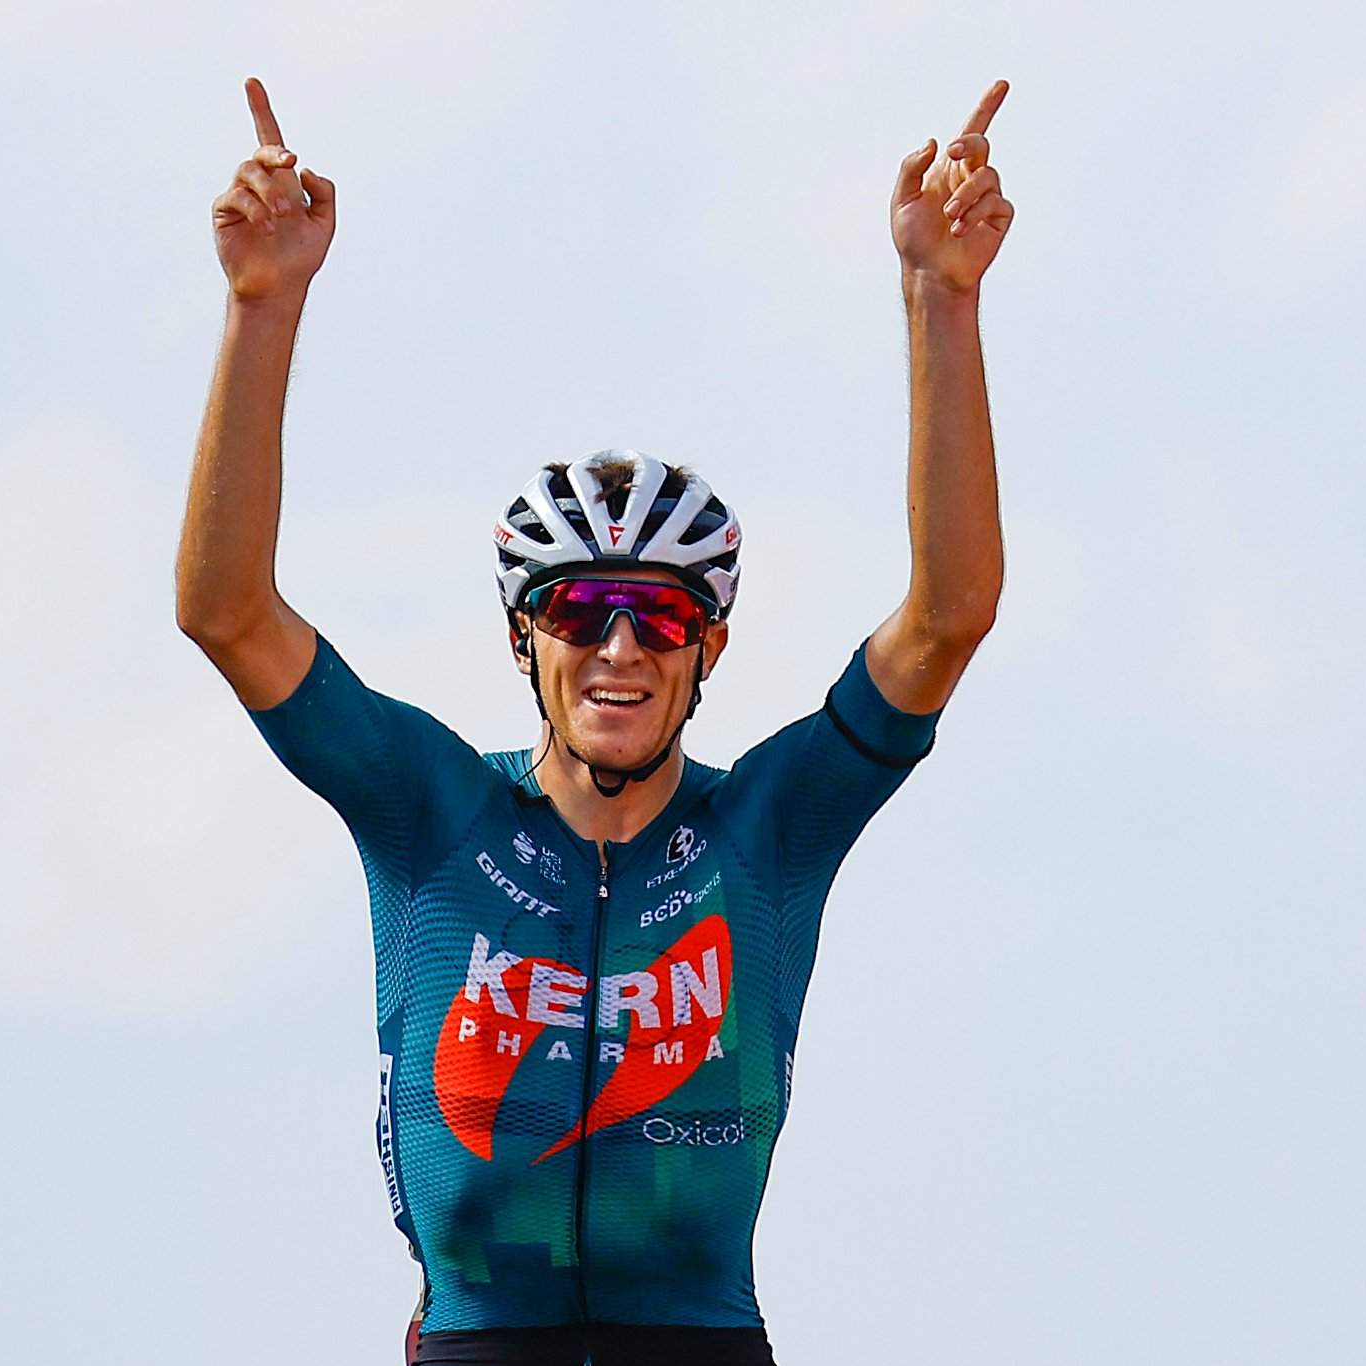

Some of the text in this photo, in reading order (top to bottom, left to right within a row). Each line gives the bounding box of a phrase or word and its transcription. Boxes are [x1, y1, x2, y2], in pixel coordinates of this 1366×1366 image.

[476, 851, 561, 917] GIANT
[464, 931, 723, 1029] KERN
[458, 1015, 724, 1065] PHARMA
[642, 1117, 744, 1146] Oxicol
